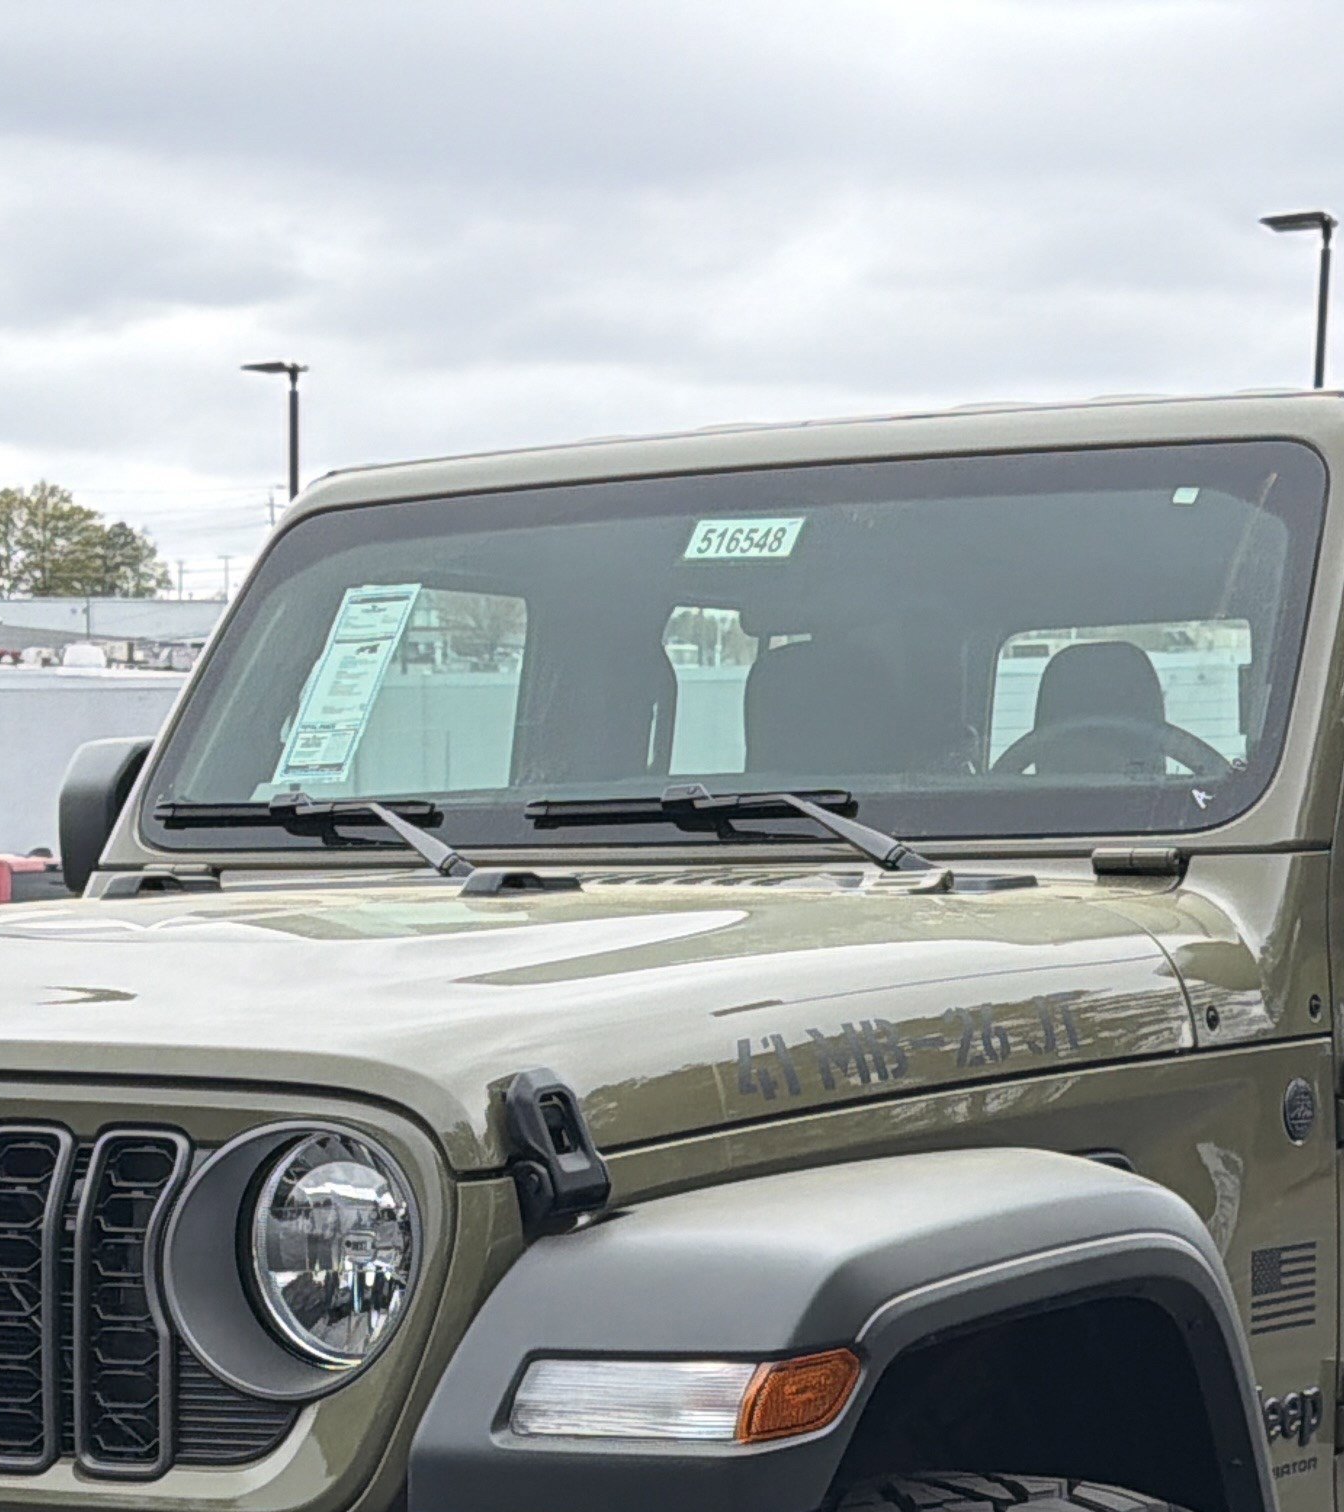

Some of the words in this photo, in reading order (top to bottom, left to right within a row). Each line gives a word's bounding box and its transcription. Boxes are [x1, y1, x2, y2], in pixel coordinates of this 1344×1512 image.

[696, 525, 787, 555] 516548
[737, 1033, 801, 1101] 41
[1257, 1385, 1321, 1447] eep
